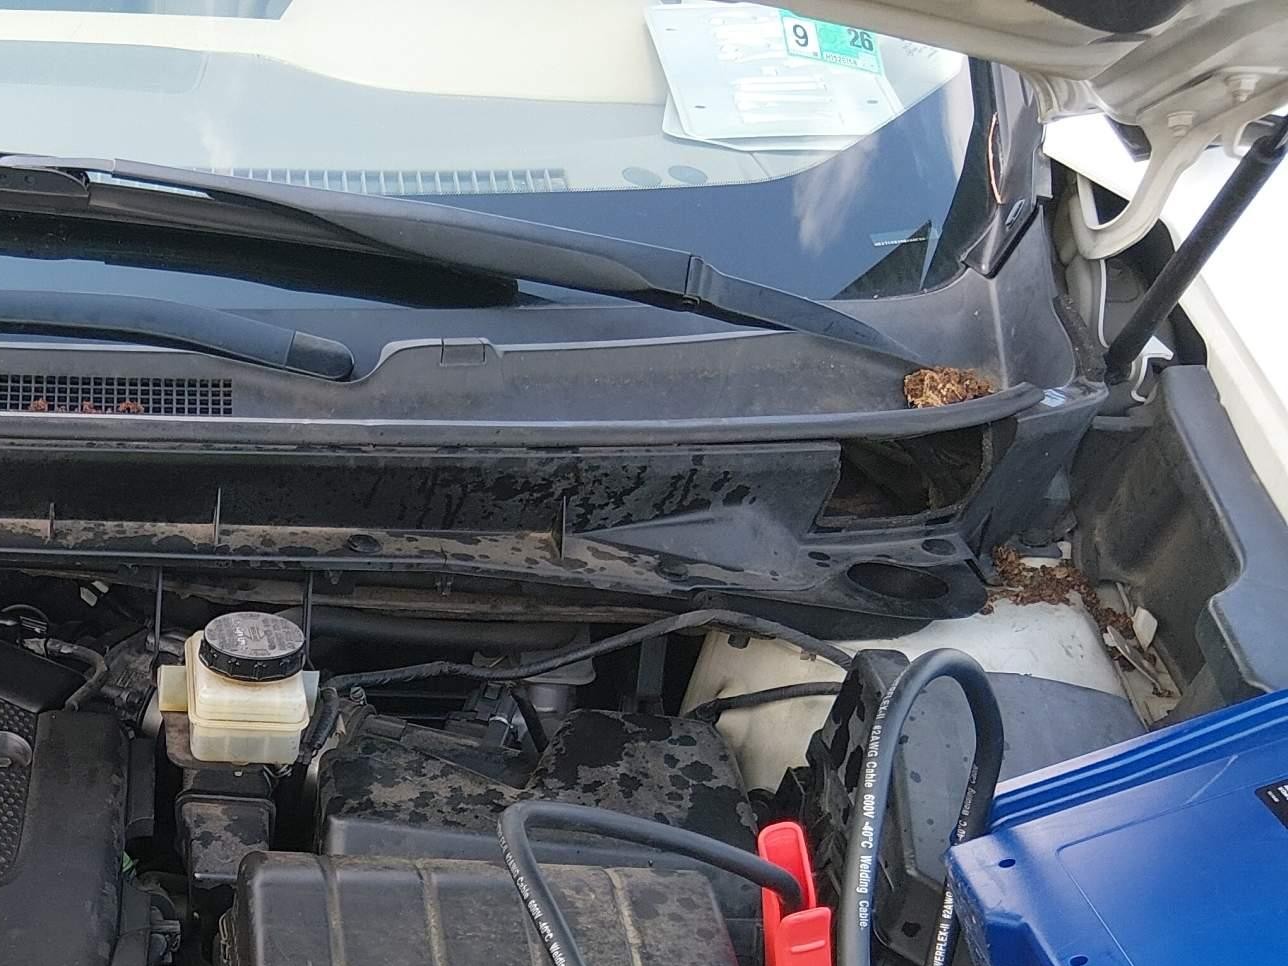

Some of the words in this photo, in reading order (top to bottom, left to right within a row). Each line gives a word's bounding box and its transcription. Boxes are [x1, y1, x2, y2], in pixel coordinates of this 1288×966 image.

[792, 24, 809, 47] 9
[847, 28, 874, 52] 26
[864, 760, 879, 790] Cable
[862, 794, 876, 821] 600V
[855, 855, 873, 895] Welding
[516, 876, 530, 900] Cable
[527, 899, 543, 921] 600V
[858, 900, 870, 929] Cable
